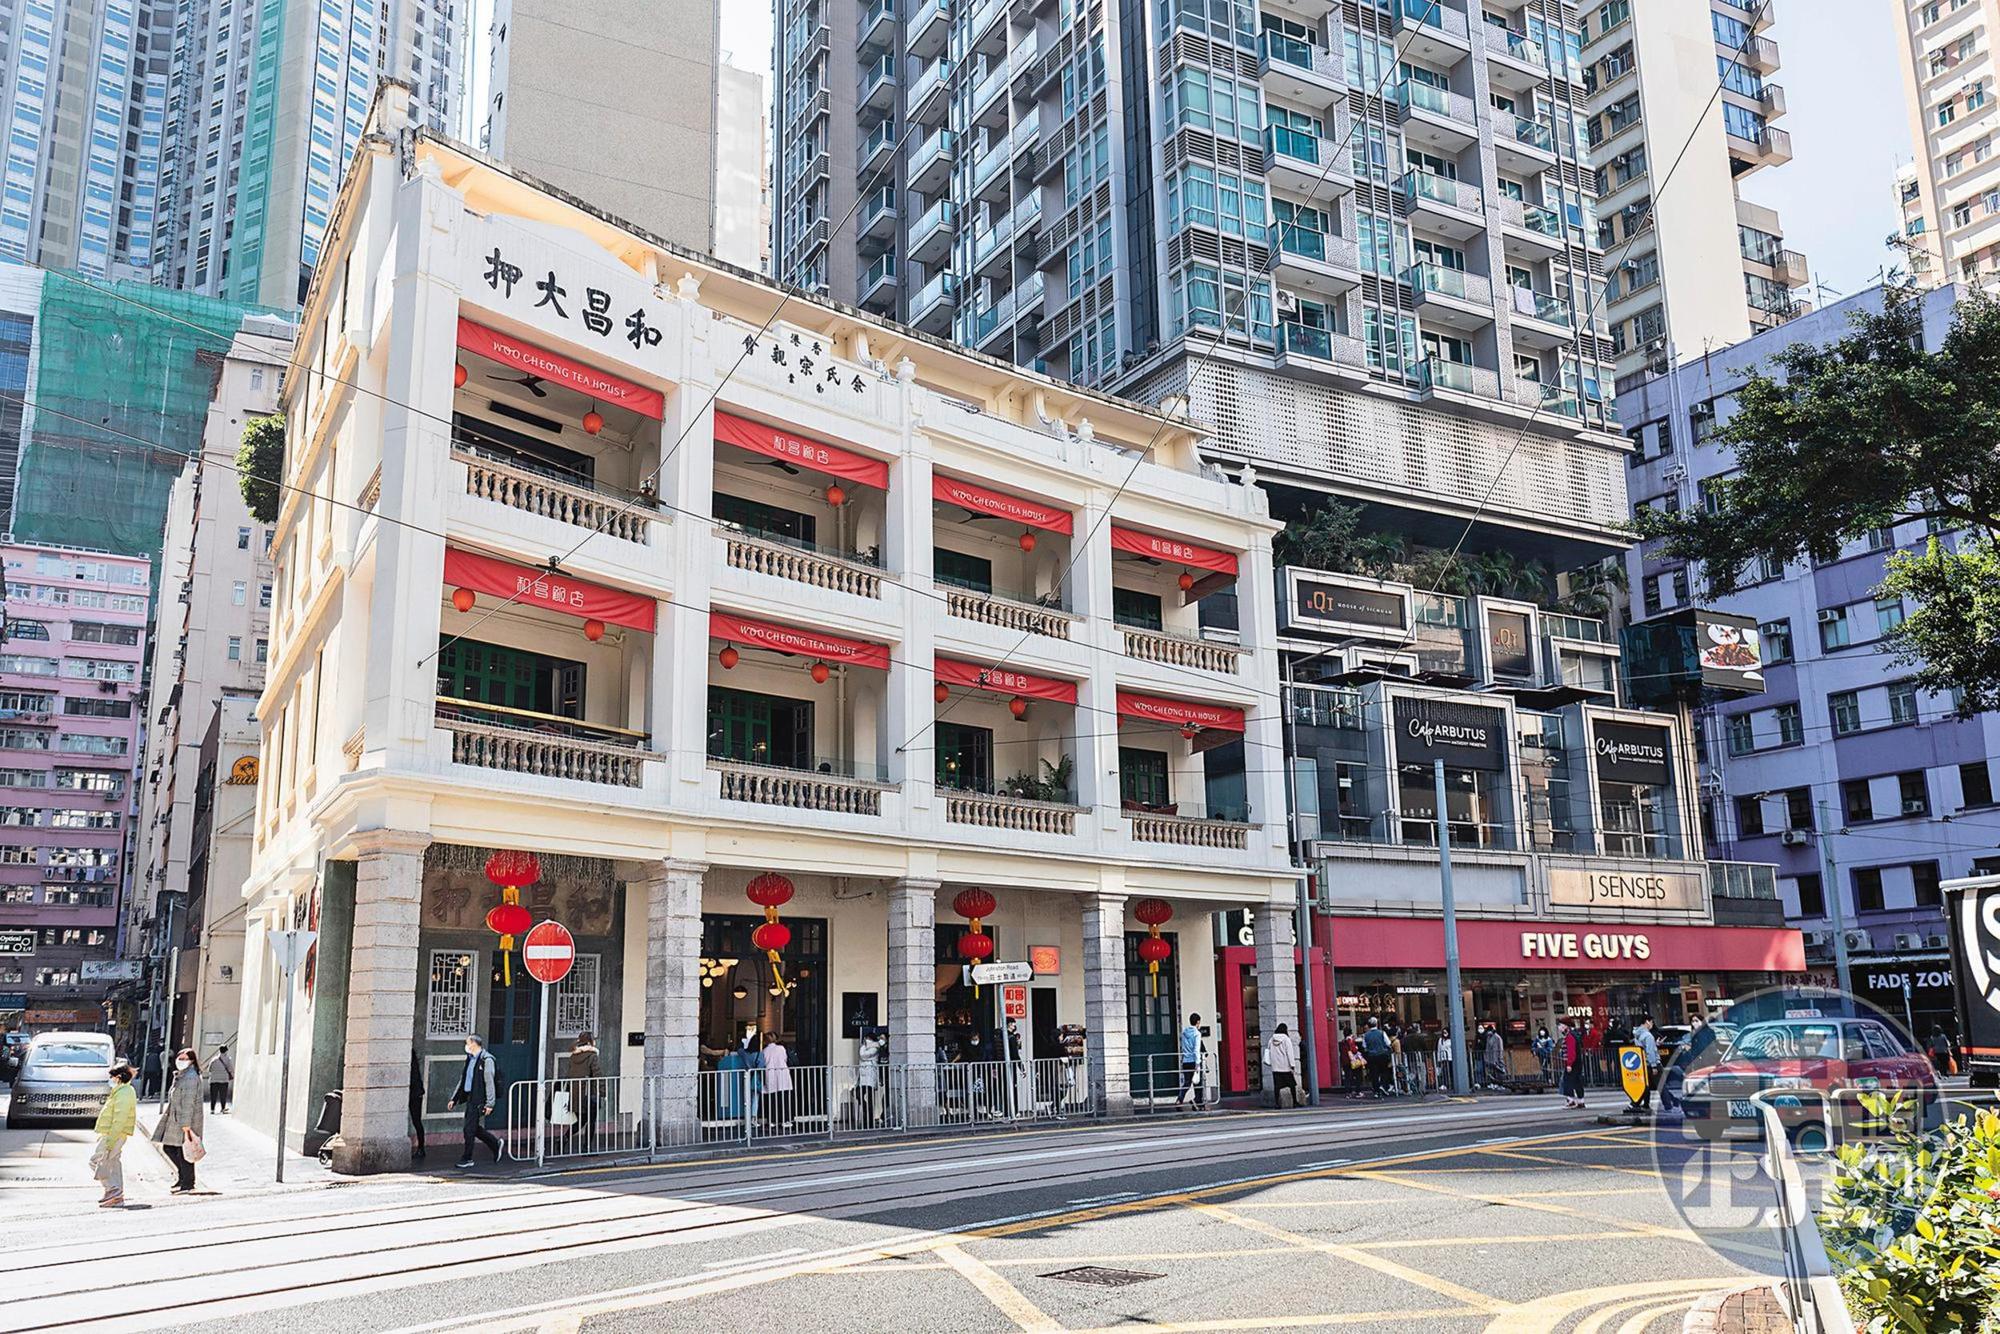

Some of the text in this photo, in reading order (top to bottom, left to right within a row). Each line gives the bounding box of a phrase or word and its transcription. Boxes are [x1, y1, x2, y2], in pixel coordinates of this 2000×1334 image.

[483, 247, 663, 350] 和昌大押
[493, 341, 627, 399] WOO CHEONG TEA HOUSE
[952, 488, 1047, 521] WOO CHEONG TEA HOUSE
[740, 625, 857, 656] WOO CHEONG TEA HOUSE
[1134, 702, 1221, 722] WOO CHEONG TEA HOUSE
[1434, 724, 1487, 741] ARBUTUS
[1618, 742, 1664, 758] ARBUTUS
[1598, 875, 1666, 900] SENSES
[1521, 932, 1651, 960] FIVE GUYS
[1868, 973, 1910, 989] FADE
[1342, 996, 1359, 1005] OPEN
[1567, 1006, 1593, 1017] GUYS
